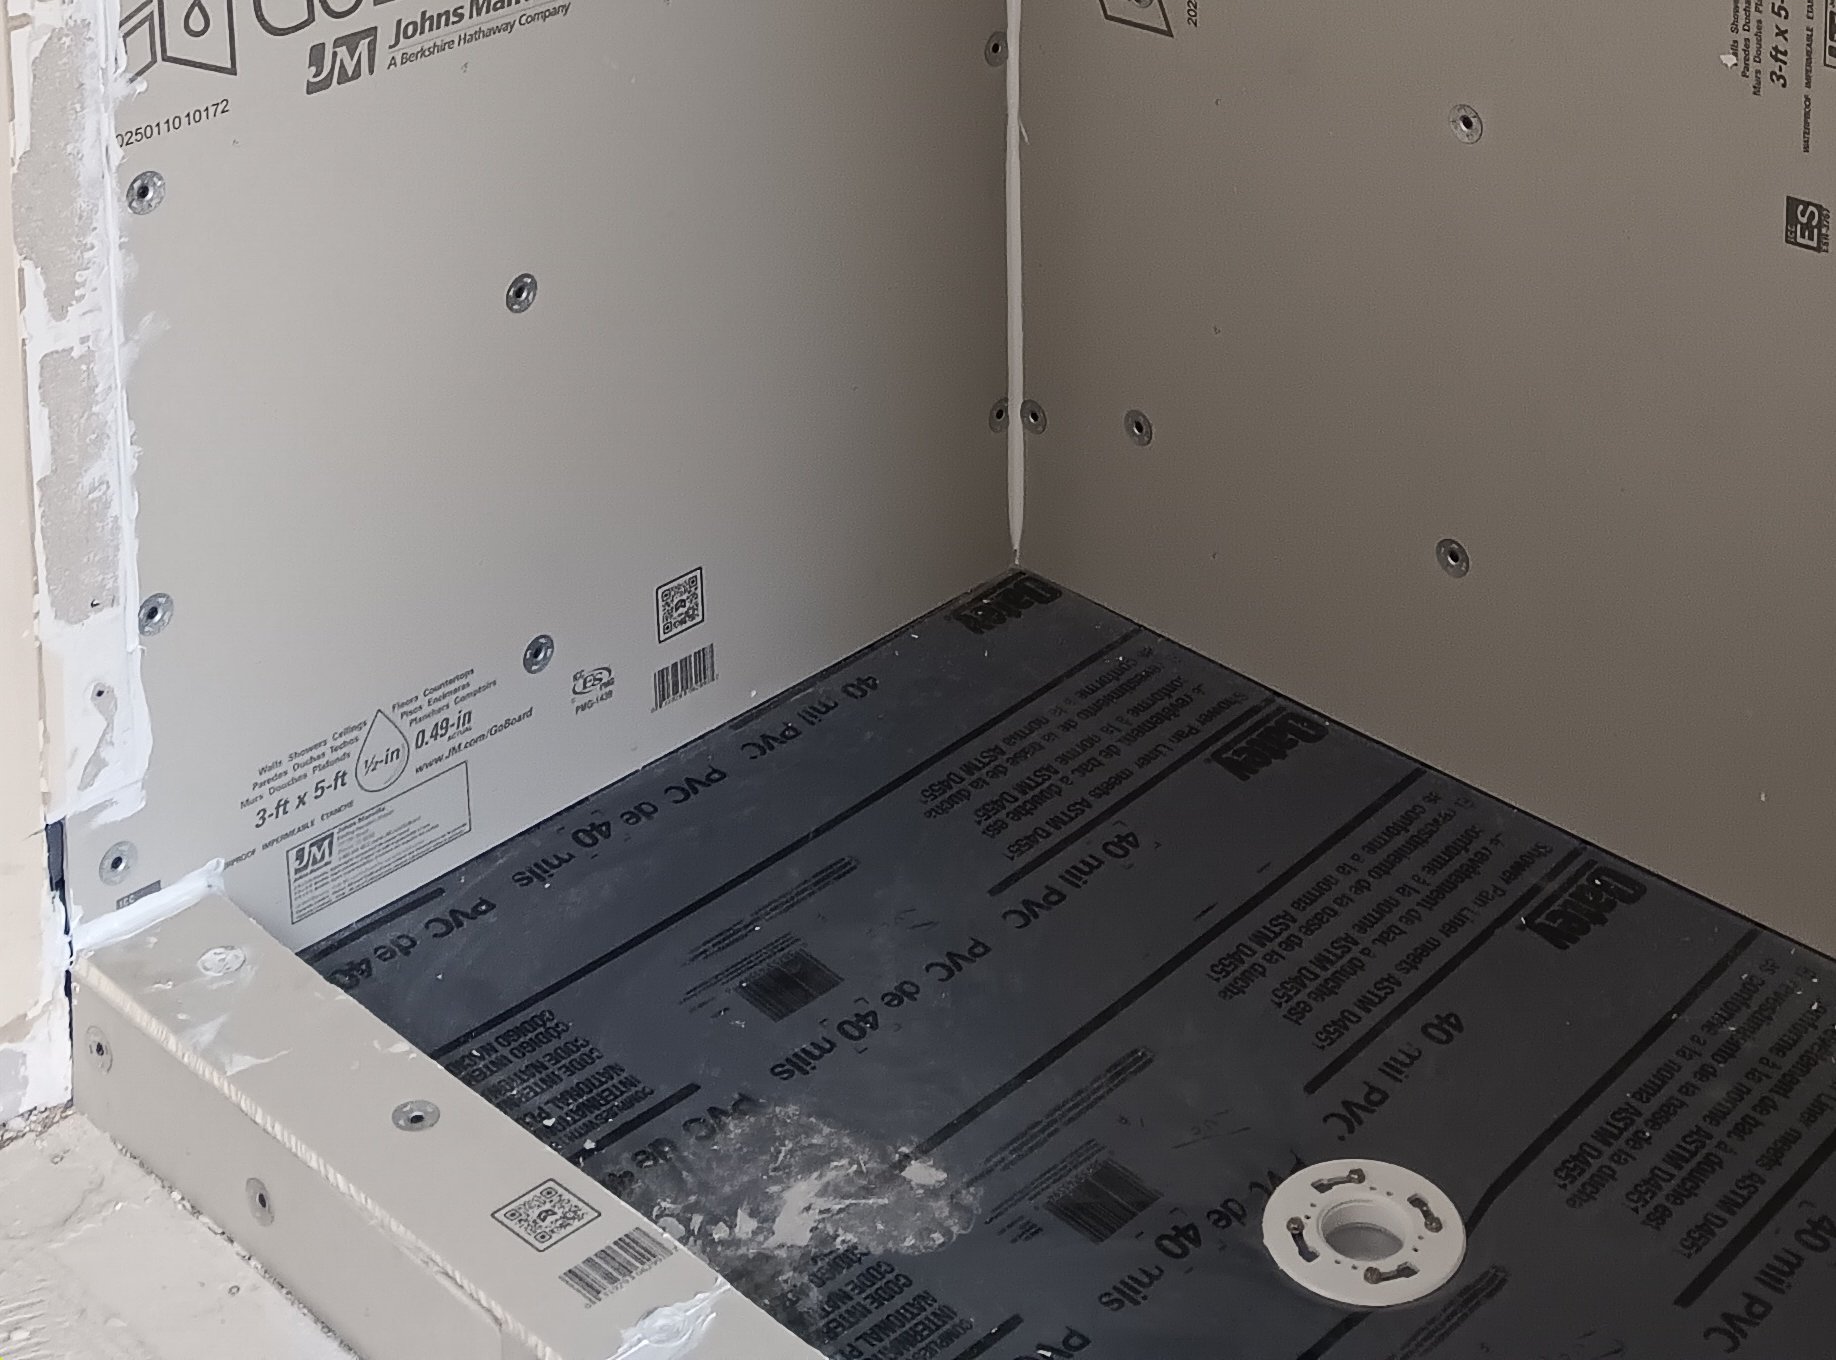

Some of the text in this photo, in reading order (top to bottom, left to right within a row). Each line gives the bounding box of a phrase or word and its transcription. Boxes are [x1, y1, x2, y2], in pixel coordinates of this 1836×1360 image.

[387, 1, 572, 70] A Berkshire Hathaway Company
[388, 2, 465, 50] Johns
[1753, 19, 1763, 64] Douches
[1774, 24, 1789, 43] x
[1741, 37, 1750, 78] Paredes
[1769, 44, 1789, 89] 3-ft
[1797, 204, 1819, 248] ES
[414, 708, 473, 750] 0.49-in
[415, 706, 534, 774] www.JM.com/GoBoard
[740, 674, 880, 760] 40 mil PVC
[254, 770, 348, 830] 3-ft x 5-ft
[512, 762, 728, 888] PVC de 40 mils
[294, 831, 335, 875] JM
[1000, 830, 1140, 930] 40 mil PVC
[424, 896, 498, 940] PVC
[373, 932, 418, 965] de
[1309, 933, 1360, 972] ASTM
[769, 936, 993, 1081] PVC de 40 mils
[1354, 973, 1403, 1014] ASTM
[1322, 1011, 1465, 1137] 40 mil PVC
[1591, 1101, 1643, 1148] ASTM
[1098, 1197, 1248, 1312] de 40 mils
[1754, 1247, 1805, 1295] mil
[1702, 1290, 1774, 1354] PVC
